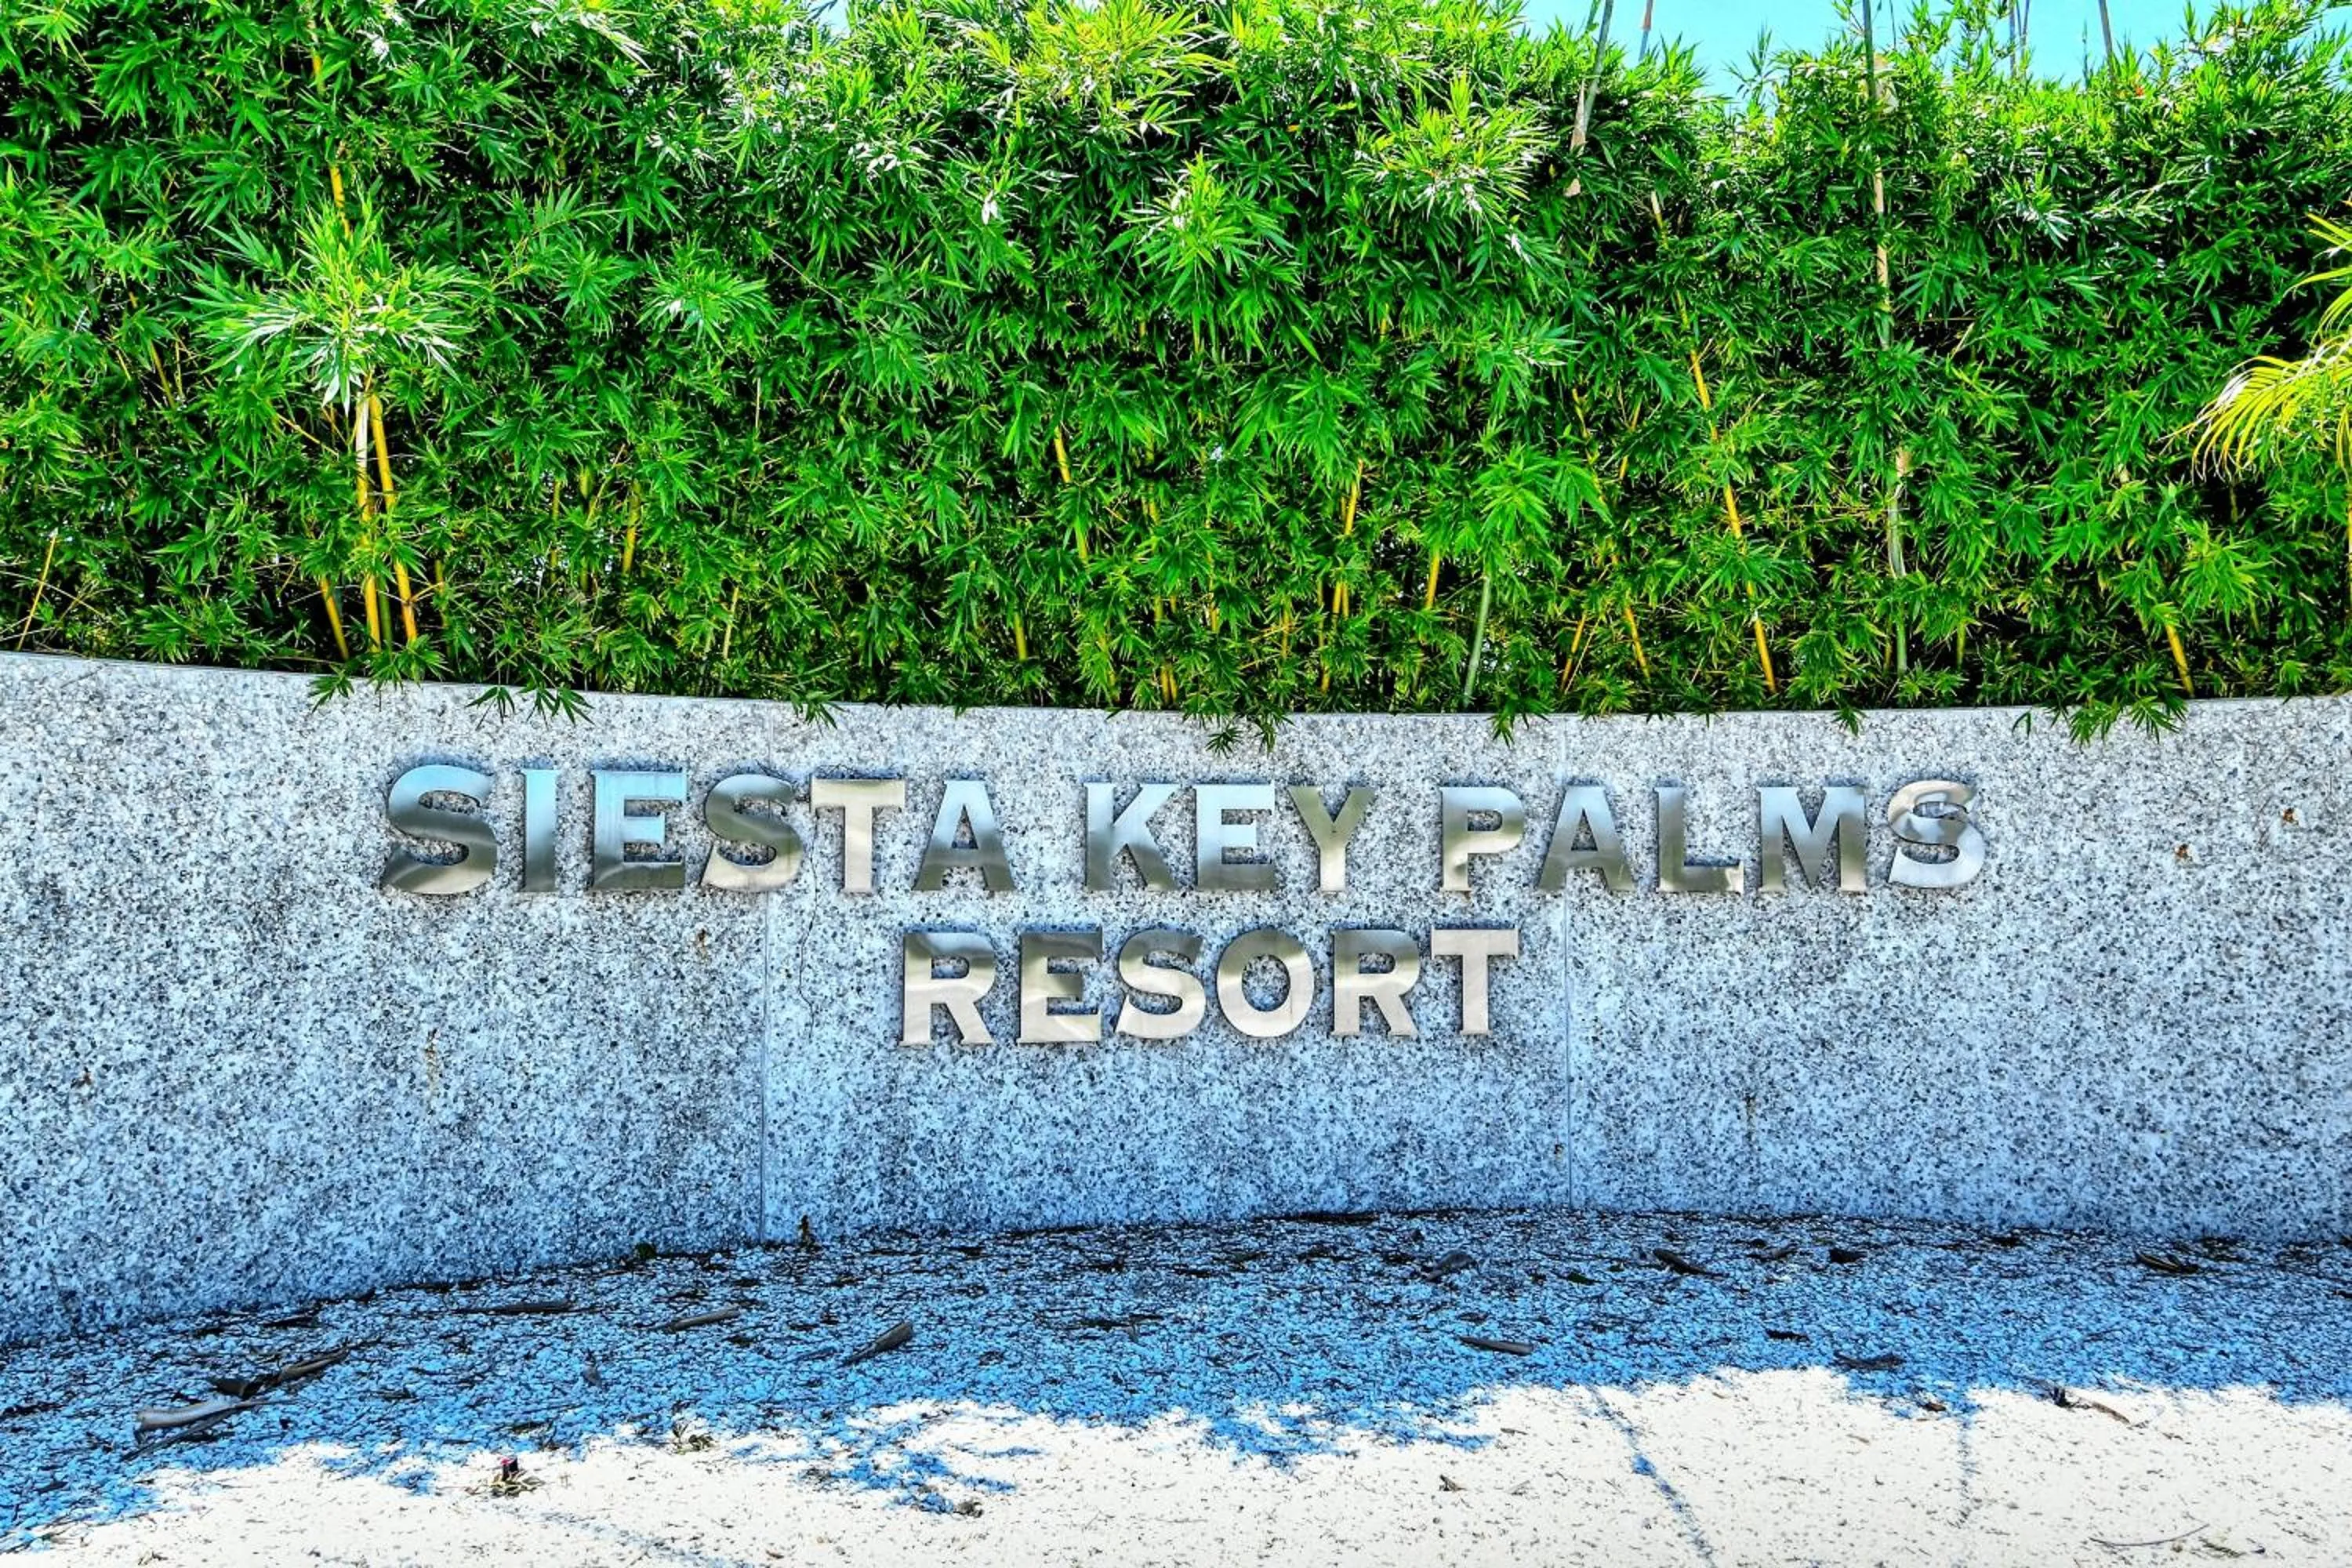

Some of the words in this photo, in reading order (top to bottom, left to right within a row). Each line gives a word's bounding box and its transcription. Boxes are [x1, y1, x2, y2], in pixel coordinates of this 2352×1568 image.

[381, 764, 1017, 894] SIESTA
[1084, 782, 1374, 892] KEY
[1439, 780, 1986, 894] PALMS
[900, 927, 1519, 1047] RESORT
